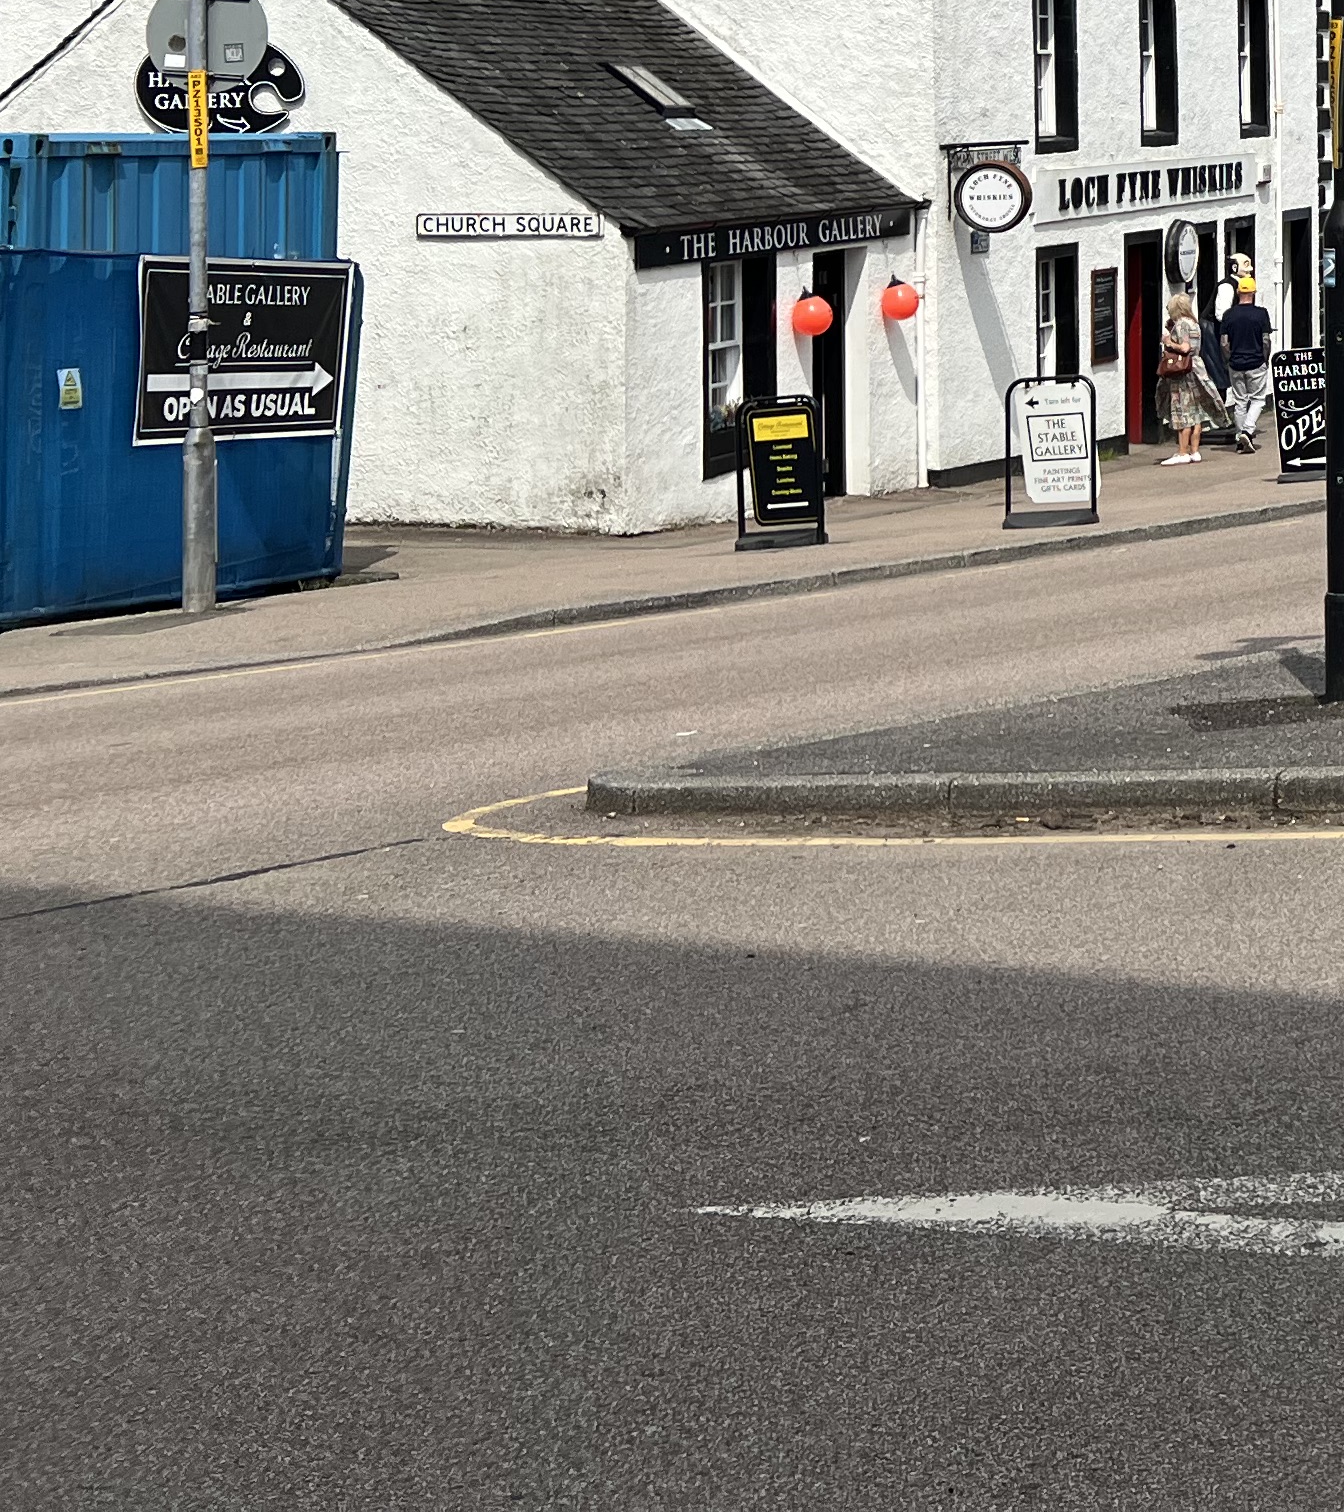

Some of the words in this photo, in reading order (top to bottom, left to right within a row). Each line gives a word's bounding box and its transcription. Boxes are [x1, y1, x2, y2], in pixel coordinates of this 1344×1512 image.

[154, 93, 245, 110] GALERY
[969, 173, 989, 190] LOCH
[1058, 174, 1109, 211] LOCH
[1116, 170, 1161, 204] FYNE
[1167, 161, 1243, 198] WHISKIES
[423, 216, 506, 233] CHURCH
[516, 216, 594, 233] SQUARE
[680, 232, 717, 260] THE
[728, 222, 810, 255] HARBOUR
[818, 214, 883, 243] GALLERY
[206, 284, 242, 304] ABLE
[245, 284, 311, 306] GALLERY
[243, 312, 252, 326] &
[231, 331, 313, 359] Restaurant
[1294, 352, 1313, 362] THE
[1274, 362, 1326, 378] HARBOU
[1278, 377, 1326, 392] GALLER
[163, 394, 218, 422] OPN
[219, 394, 246, 419] AS
[250, 392, 316, 418] USUAL
[1045, 418, 1066, 430] THE
[1281, 404, 1326, 451] OPE
[1037, 430, 1077, 444] STABLE
[1034, 444, 1083, 457] GALLERY
[1043, 467, 1081, 476] PAINTINGS
[1034, 477, 1049, 485] FINE
[1051, 476, 1065, 484] ART
[1063, 482, 1087, 491] CARDS
